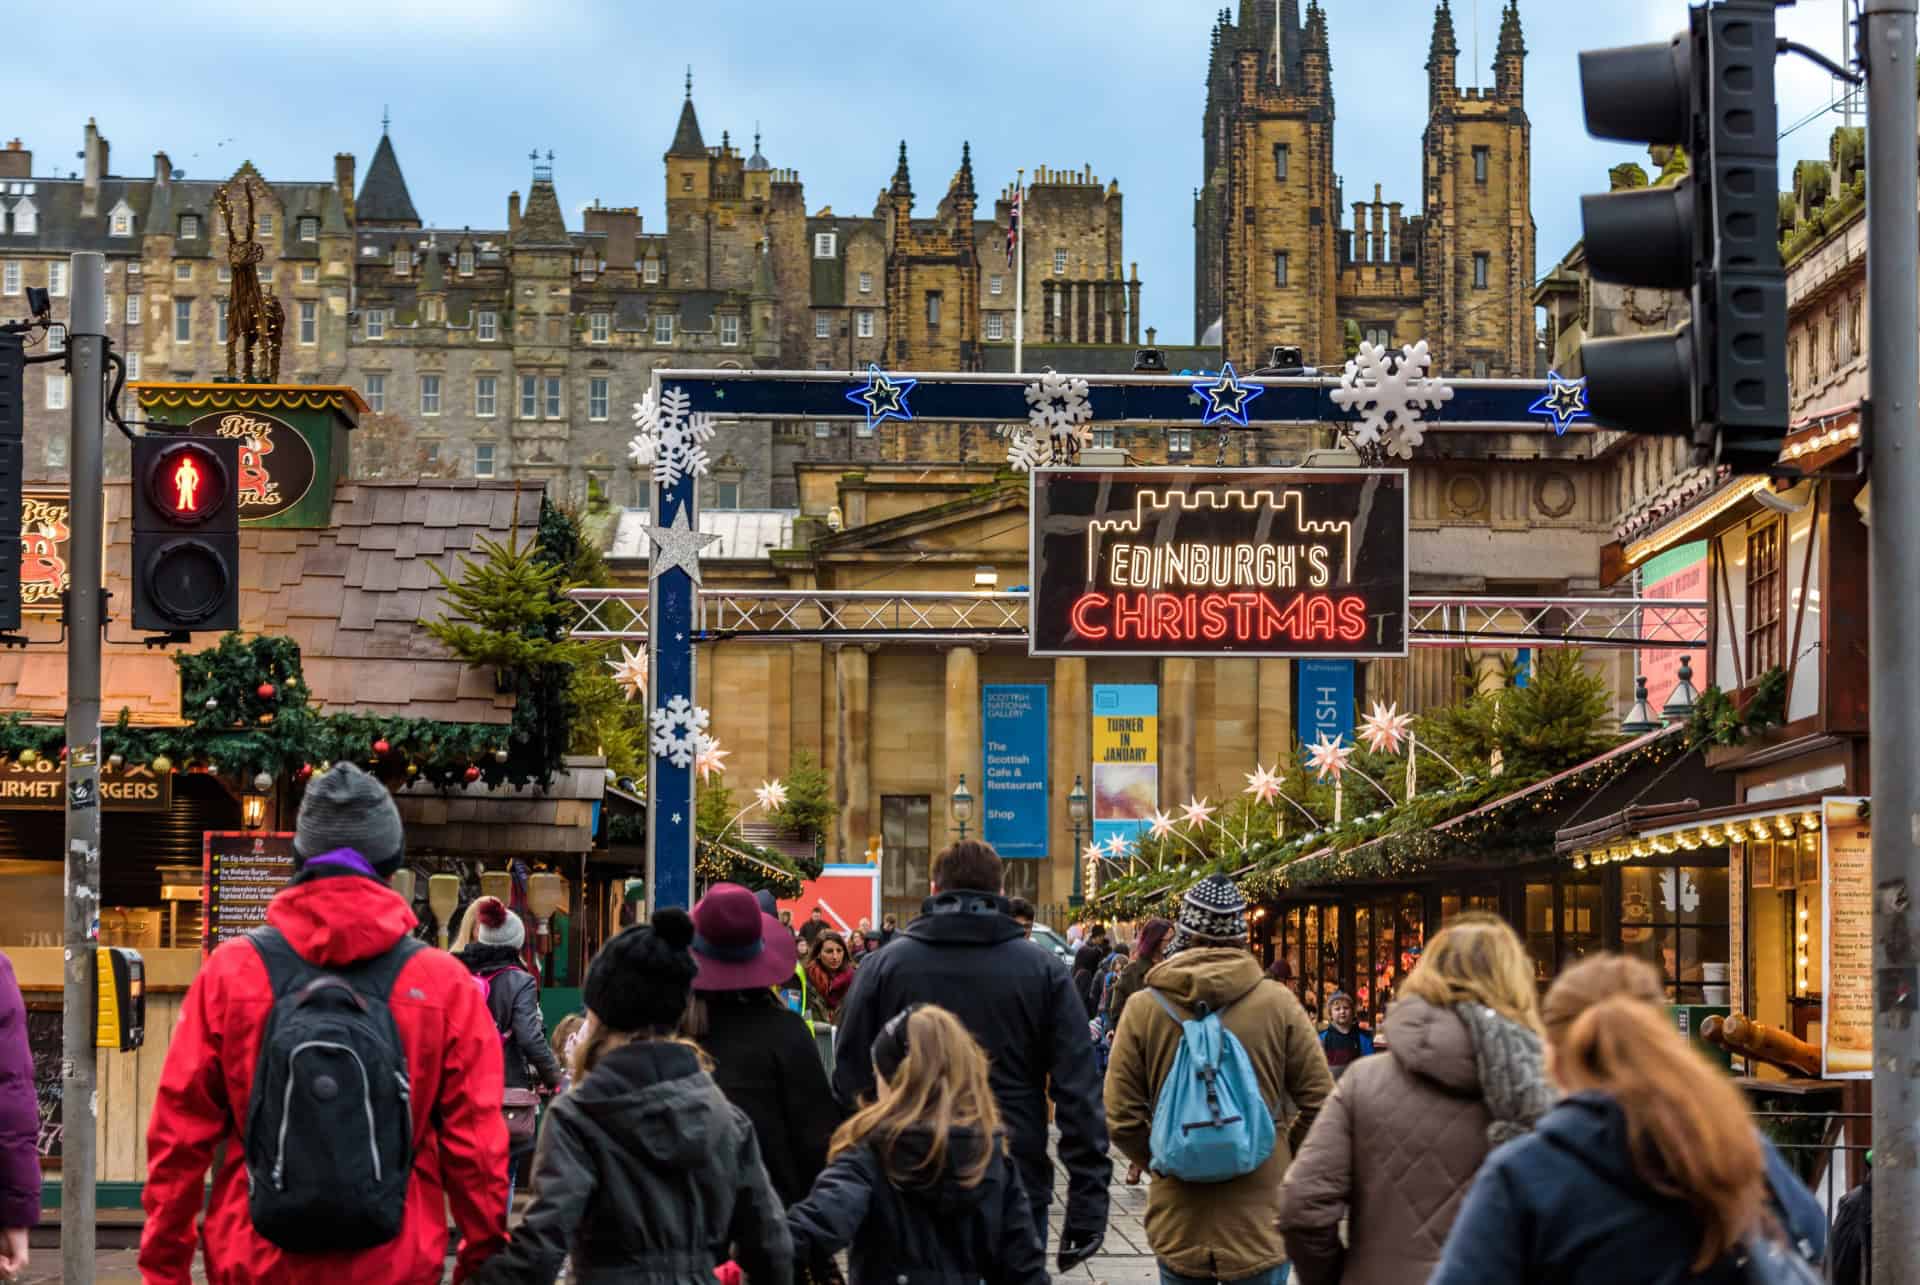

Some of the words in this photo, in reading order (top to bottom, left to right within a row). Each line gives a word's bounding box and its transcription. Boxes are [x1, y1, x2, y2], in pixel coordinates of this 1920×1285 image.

[216, 414, 272, 438] Big
[1110, 542, 1329, 589] EDINBURGH'S
[1071, 592, 1367, 640] CHRISTMAS
[987, 693, 1030, 702] SCOTTISH
[987, 702, 1032, 710] NATIONAL
[987, 711, 1024, 719] GALLERY
[1107, 717, 1144, 732] TURNER
[1120, 734, 1130, 746] IN
[988, 742, 1007, 752] The
[988, 754, 1029, 765] Scottish
[1104, 748, 1147, 762] JANUARY
[1014, 768, 1022, 777] &
[988, 781, 1043, 791] Restaurant
[988, 809, 1015, 821] Shop
